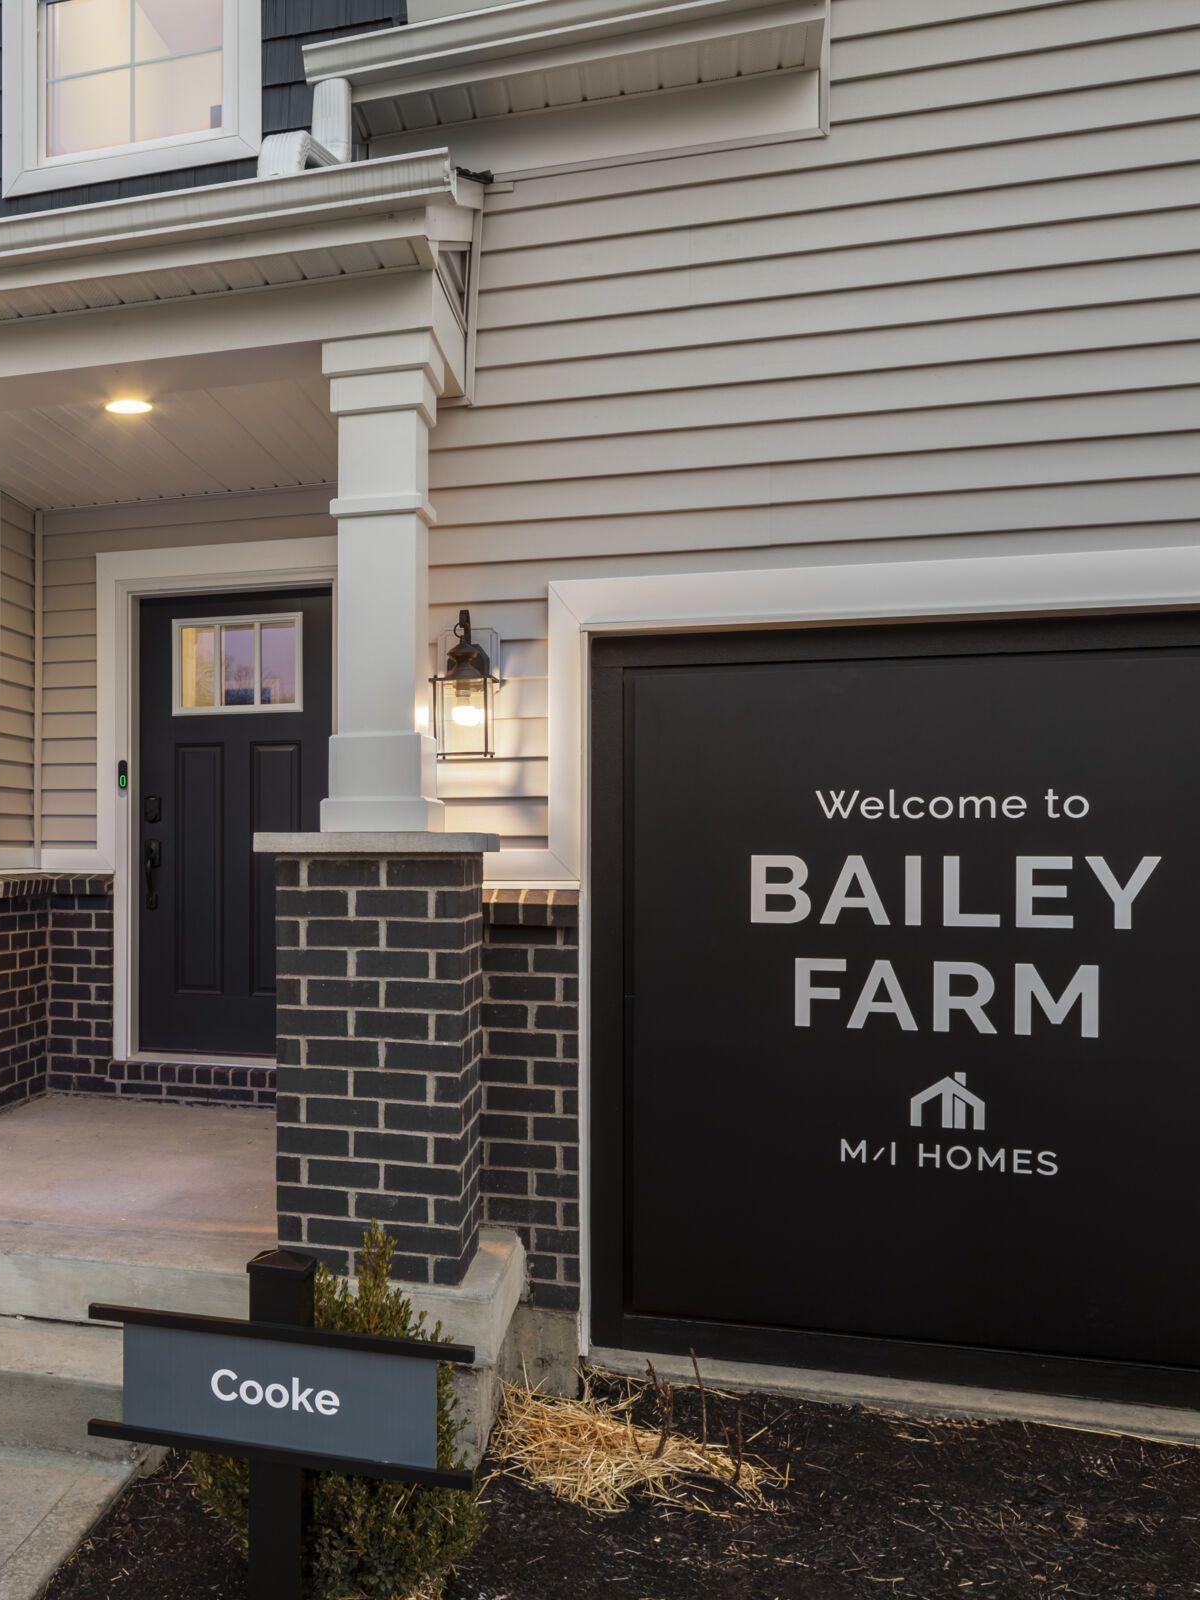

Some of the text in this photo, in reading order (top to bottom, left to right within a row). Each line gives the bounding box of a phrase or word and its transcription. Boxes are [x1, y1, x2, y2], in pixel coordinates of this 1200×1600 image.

[816, 789, 1089, 819] Welcome to
[751, 855, 1162, 929] BAILEY
[795, 958, 1099, 1038] FARM
[919, 1144, 1058, 1175] HOMES
[211, 1369, 339, 1415] Cooke
